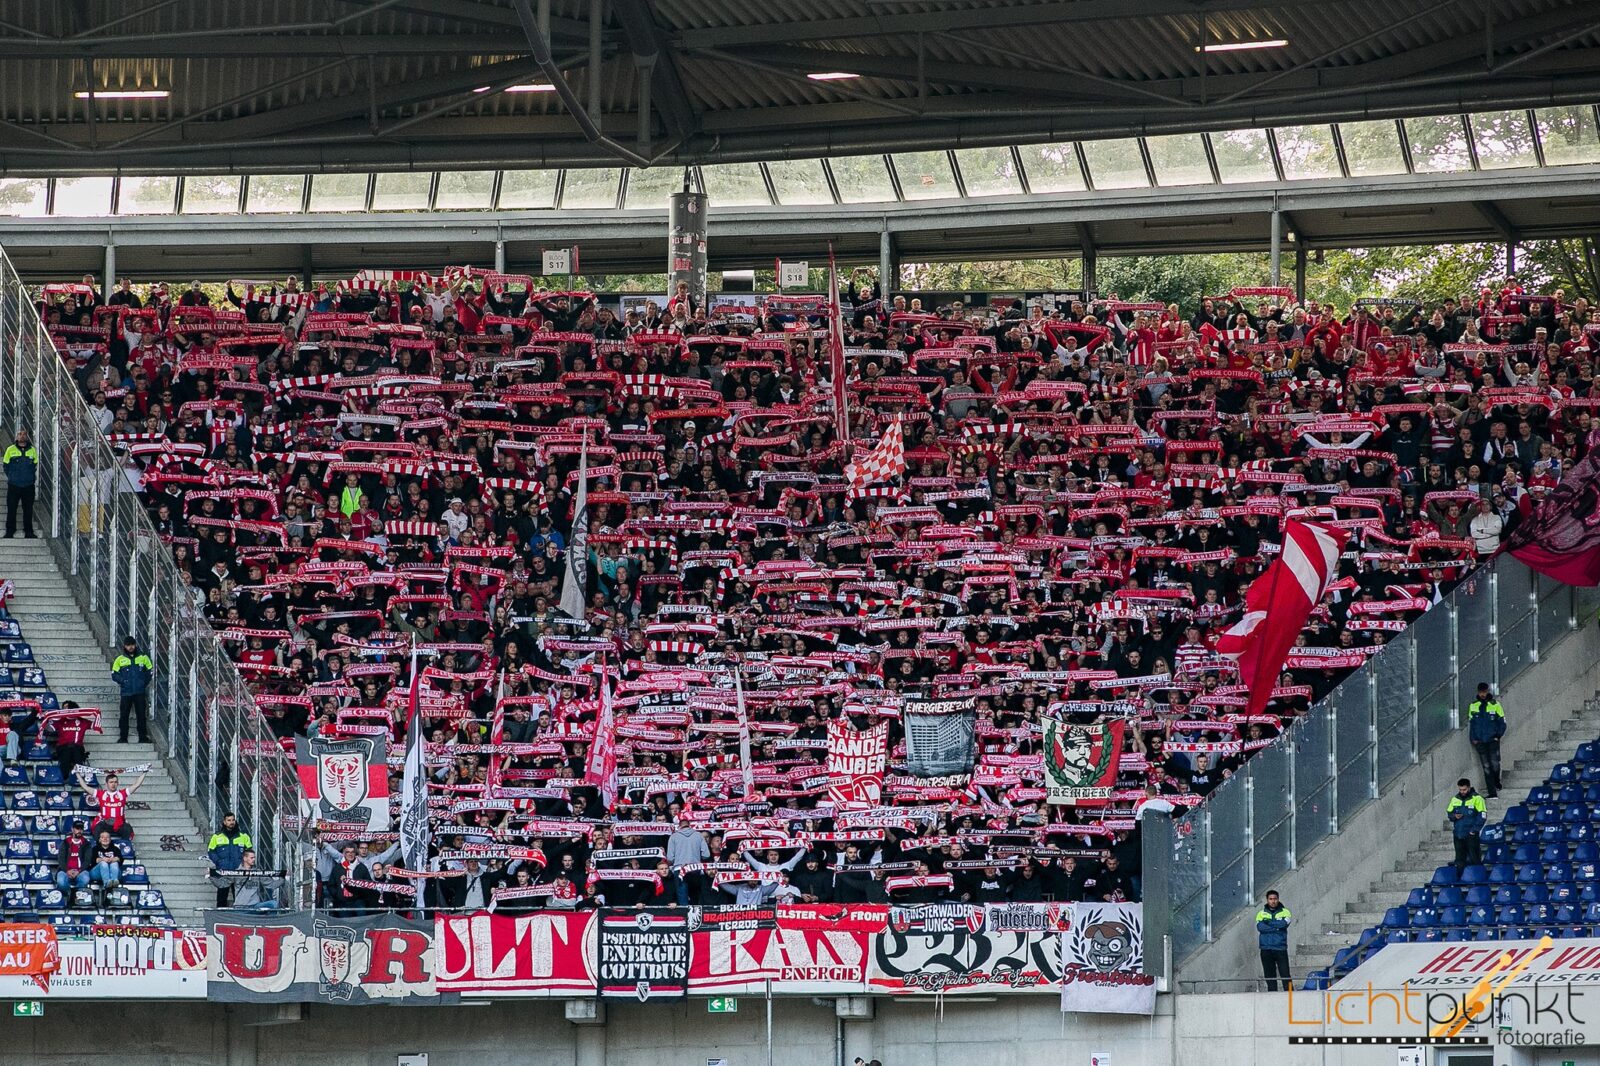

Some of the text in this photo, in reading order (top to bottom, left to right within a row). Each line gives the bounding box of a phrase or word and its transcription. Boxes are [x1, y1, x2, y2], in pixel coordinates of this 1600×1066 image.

[905, 697, 976, 714] ENERGIEBEZIRK
[335, 724, 378, 733] COTTBUS
[860, 720, 888, 740] DEINE
[827, 734, 887, 757] BANDE
[828, 753, 886, 775] SAUBER
[437, 825, 489, 835] CHOSEBUZ
[615, 825, 670, 833] SCHMELLWITZ
[847, 817, 906, 828] ENERGIE
[685, 862, 746, 873] NUR ENERGIE
[719, 903, 758, 912] BERLIN
[777, 909, 887, 922] ELSTER FRONT
[905, 903, 973, 920] FINSTERWALDER
[703, 911, 774, 922] BRANDENBURG
[96, 927, 161, 939] sektion
[718, 921, 759, 931] TERROR
[922, 917, 956, 933] JUNGS
[601, 932, 687, 946] PSEUDOFANS
[94, 930, 174, 970] nord
[601, 945, 687, 963] ENERGIE
[67, 956, 92, 977] VON
[600, 963, 687, 980] COTTBUS
[780, 966, 861, 982] ENERGIE
[903, 972, 926, 988] Die
[971, 975, 987, 985] von
